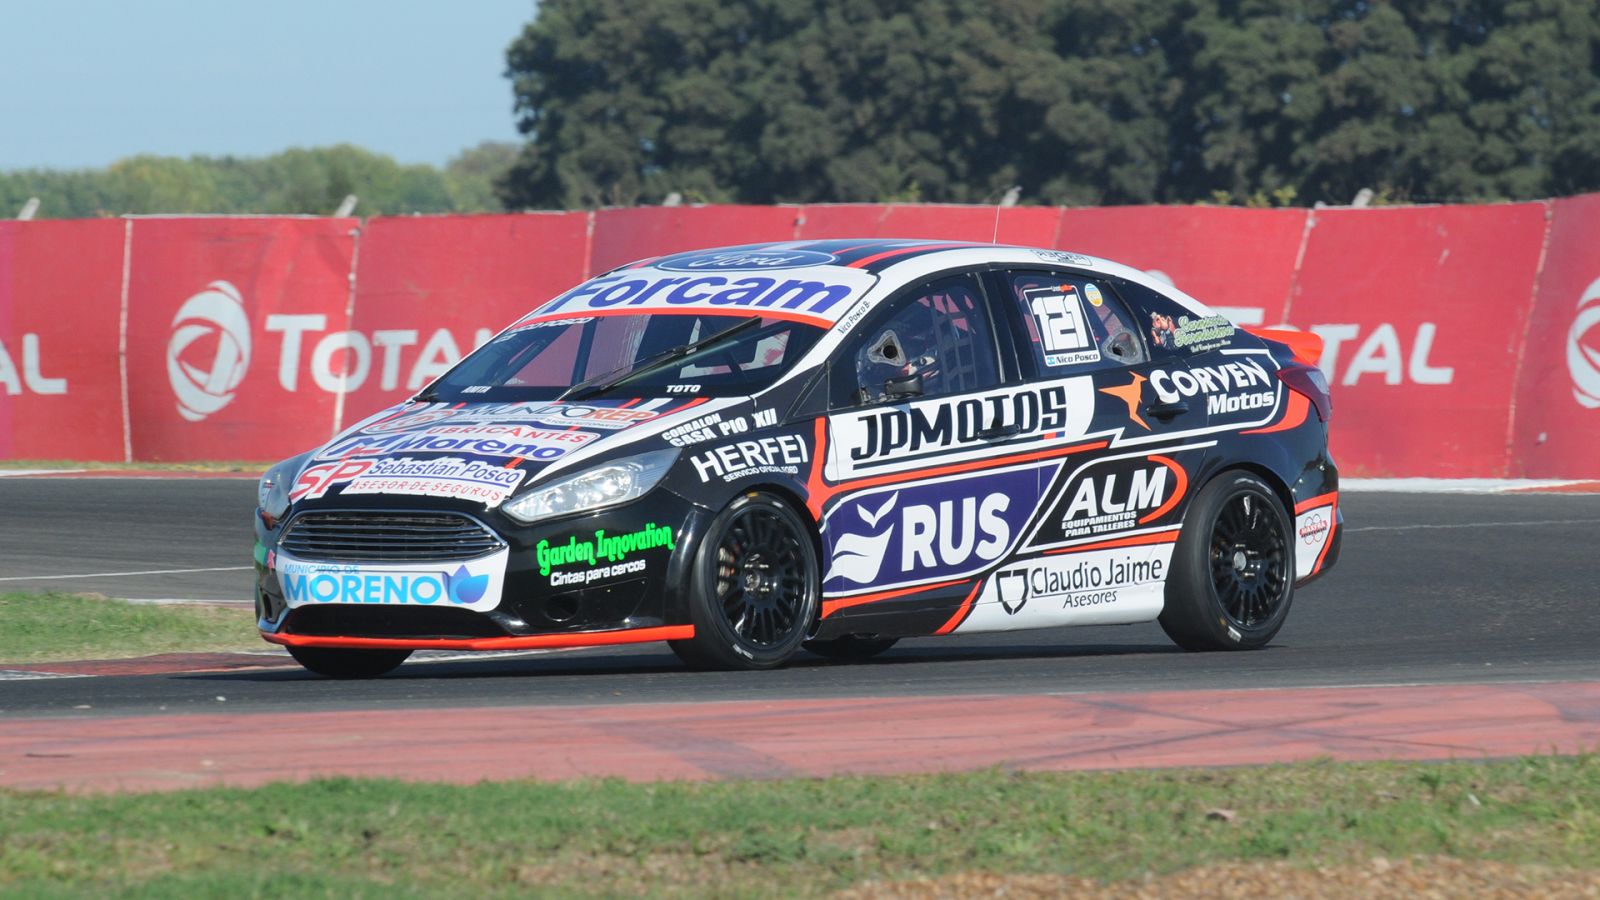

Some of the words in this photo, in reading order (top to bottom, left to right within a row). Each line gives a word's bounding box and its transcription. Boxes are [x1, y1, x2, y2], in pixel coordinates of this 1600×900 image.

[539, 275, 852, 314] Forcam
[1031, 294, 1089, 351] 121
[1056, 355, 1073, 364] Nico
[1074, 353, 1098, 362] Posco
[666, 384, 701, 393] TOTO
[1150, 357, 1271, 403] CORVEN
[1208, 391, 1274, 415] Motos
[661, 413, 722, 441] CORRALON
[669, 426, 717, 447] CASA
[718, 416, 748, 436] PIO
[850, 386, 1067, 461] JPMOTOS
[387, 436, 567, 460] Moreno
[690, 434, 808, 483] HERFEI
[460, 464, 521, 483] Posco
[723, 467, 759, 482] SERVICIO
[1062, 465, 1168, 521] ALM
[902, 492, 1012, 572] RUS
[1061, 511, 1137, 530] EQUIPAMIENTOS
[1065, 526, 1091, 538] PARA
[1092, 519, 1136, 534] TALLERES
[536, 535, 597, 577] Garden
[595, 522, 676, 562] Innovation
[344, 565, 360, 575] DE
[550, 570, 586, 587] Cintas
[585, 564, 611, 585] para
[611, 559, 646, 577] cercos
[1031, 561, 1102, 595] Claudio
[1105, 556, 1162, 586] Jaime
[284, 574, 442, 604] MORENO
[1063, 590, 1118, 609] Asesores
